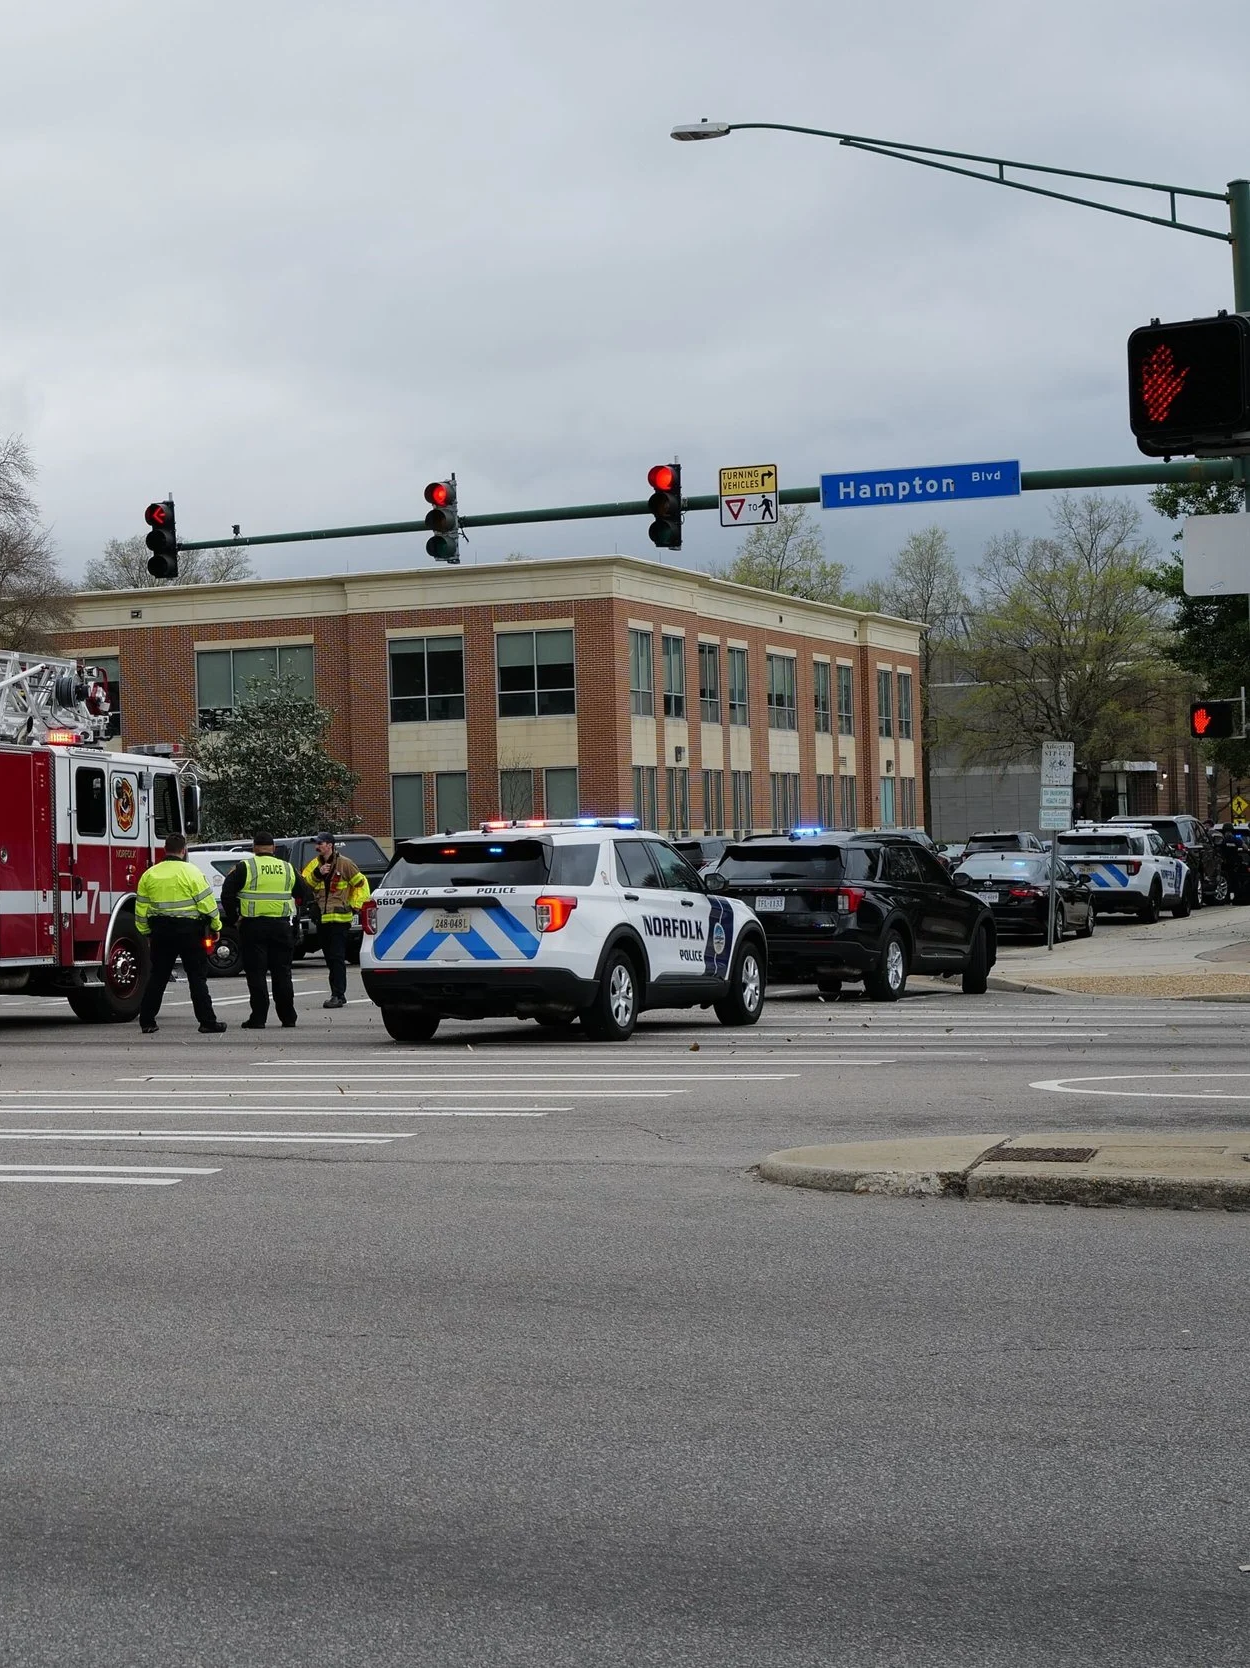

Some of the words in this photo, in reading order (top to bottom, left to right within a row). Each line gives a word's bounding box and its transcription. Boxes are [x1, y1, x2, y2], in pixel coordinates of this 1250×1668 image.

[722, 470, 759, 480] TURNING
[722, 480, 759, 490] VEHICLES
[839, 477, 955, 500] Hampton
[971, 470, 1001, 482] Blvd
[748, 503, 758, 511] TO
[261, 865, 283, 875] POLICE
[87, 881, 100, 924] 7
[642, 915, 704, 940] NORFOLK
[679, 949, 703, 961] POLICE
